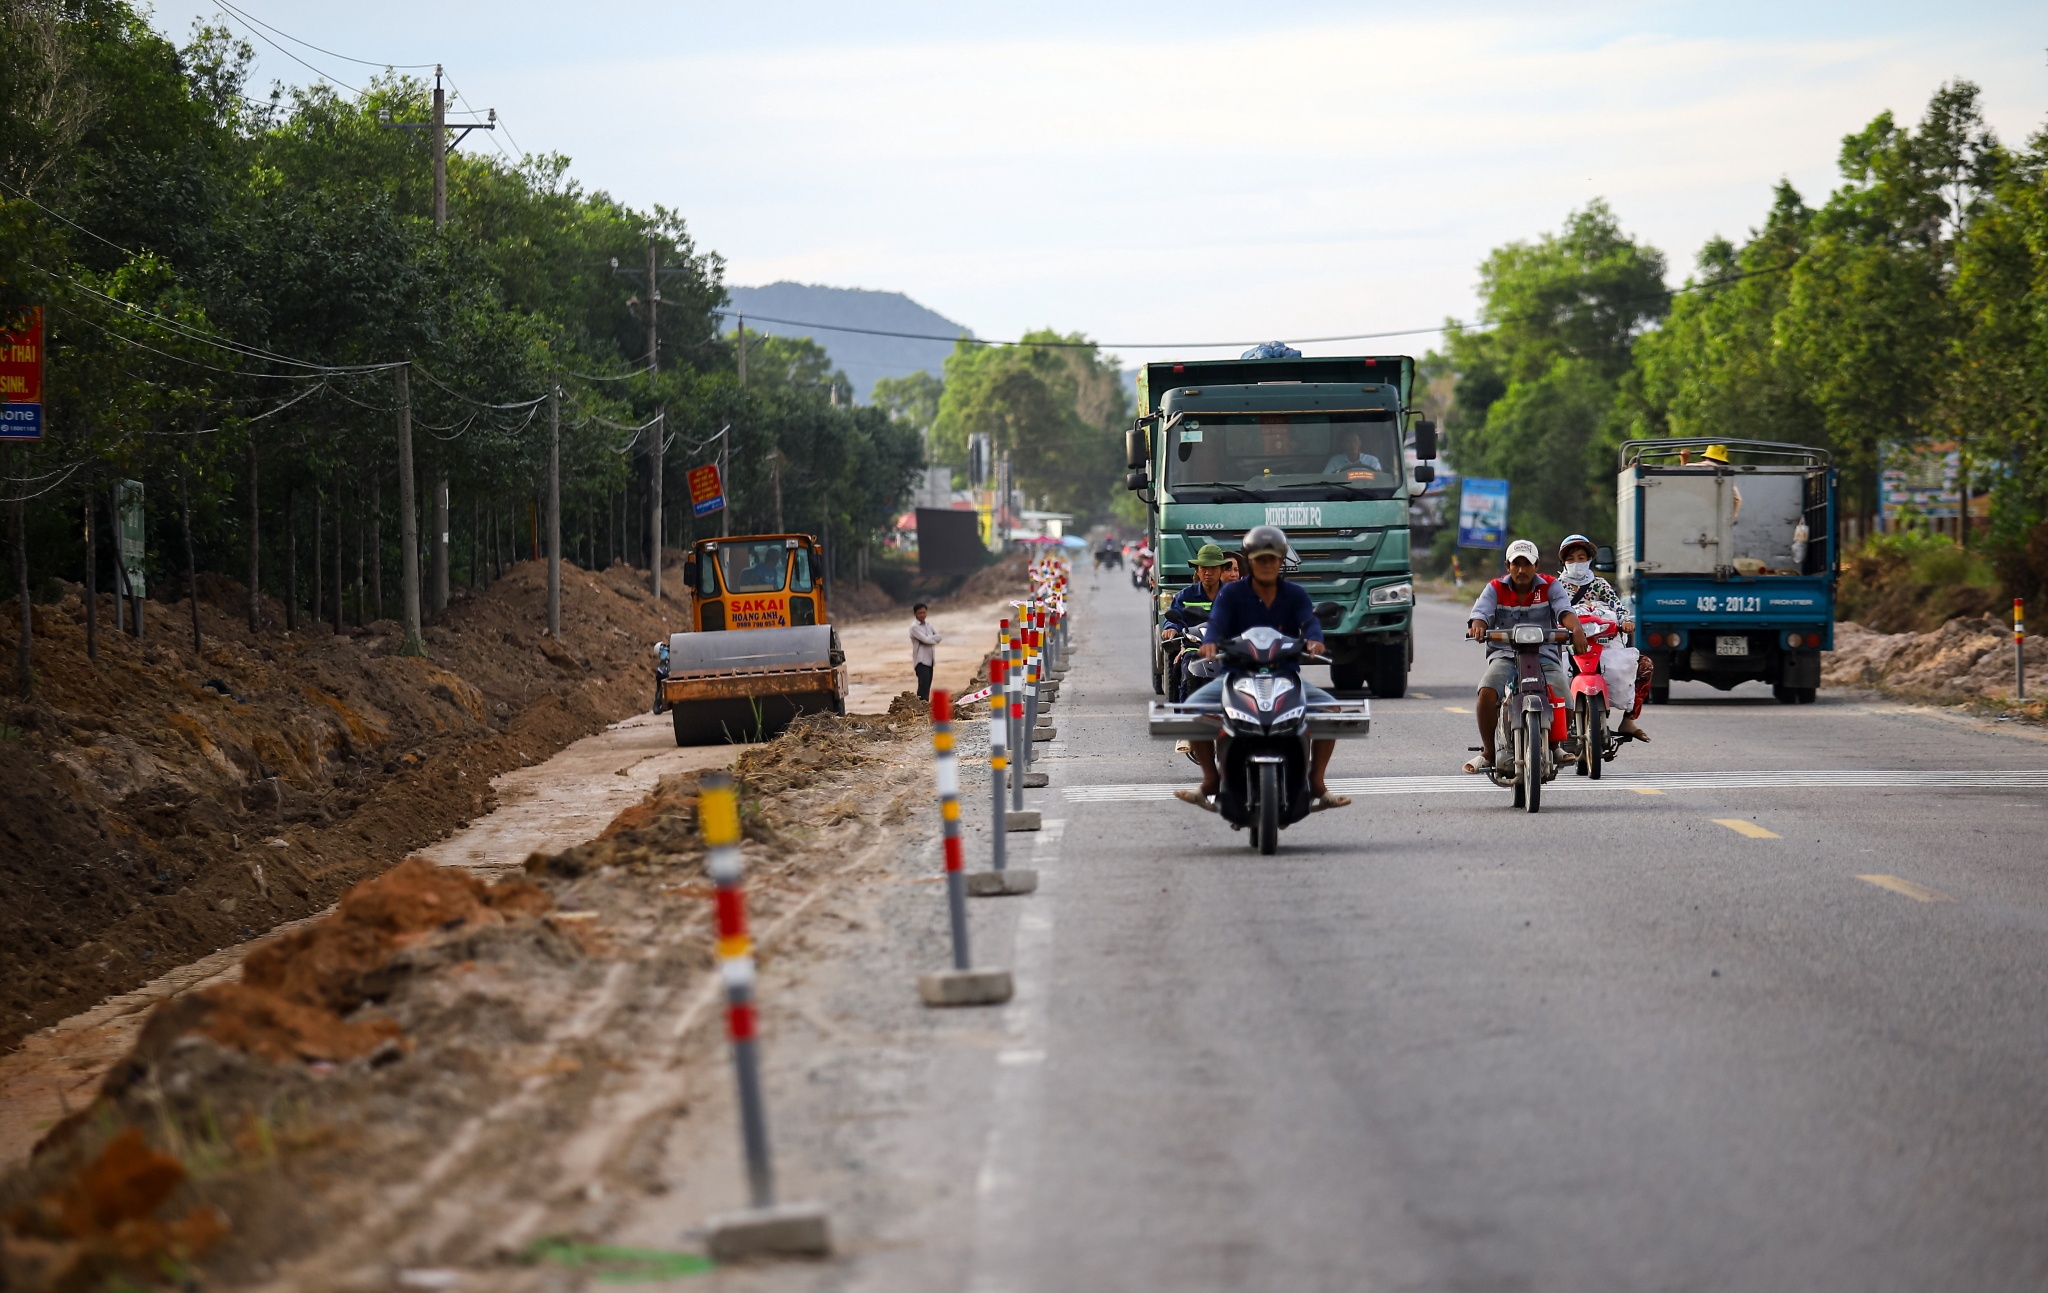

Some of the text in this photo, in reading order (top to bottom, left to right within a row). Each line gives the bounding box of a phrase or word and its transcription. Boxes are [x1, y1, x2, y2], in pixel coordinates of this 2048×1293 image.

[11, 338, 36, 363] THẢI
[0, 375, 29, 394] SINH.
[1265, 507, 1287, 526] MINH
[1310, 506, 1322, 528] PQ
[1185, 523, 1225, 531] HOWO
[731, 599, 784, 612] SAKAI
[1696, 596, 1717, 612] 43C
[1726, 596, 1761, 612] 201.21
[762, 611, 778, 620] ANH
[778, 615, 786, 627] 4
[1723, 637, 1741, 646] 43C
